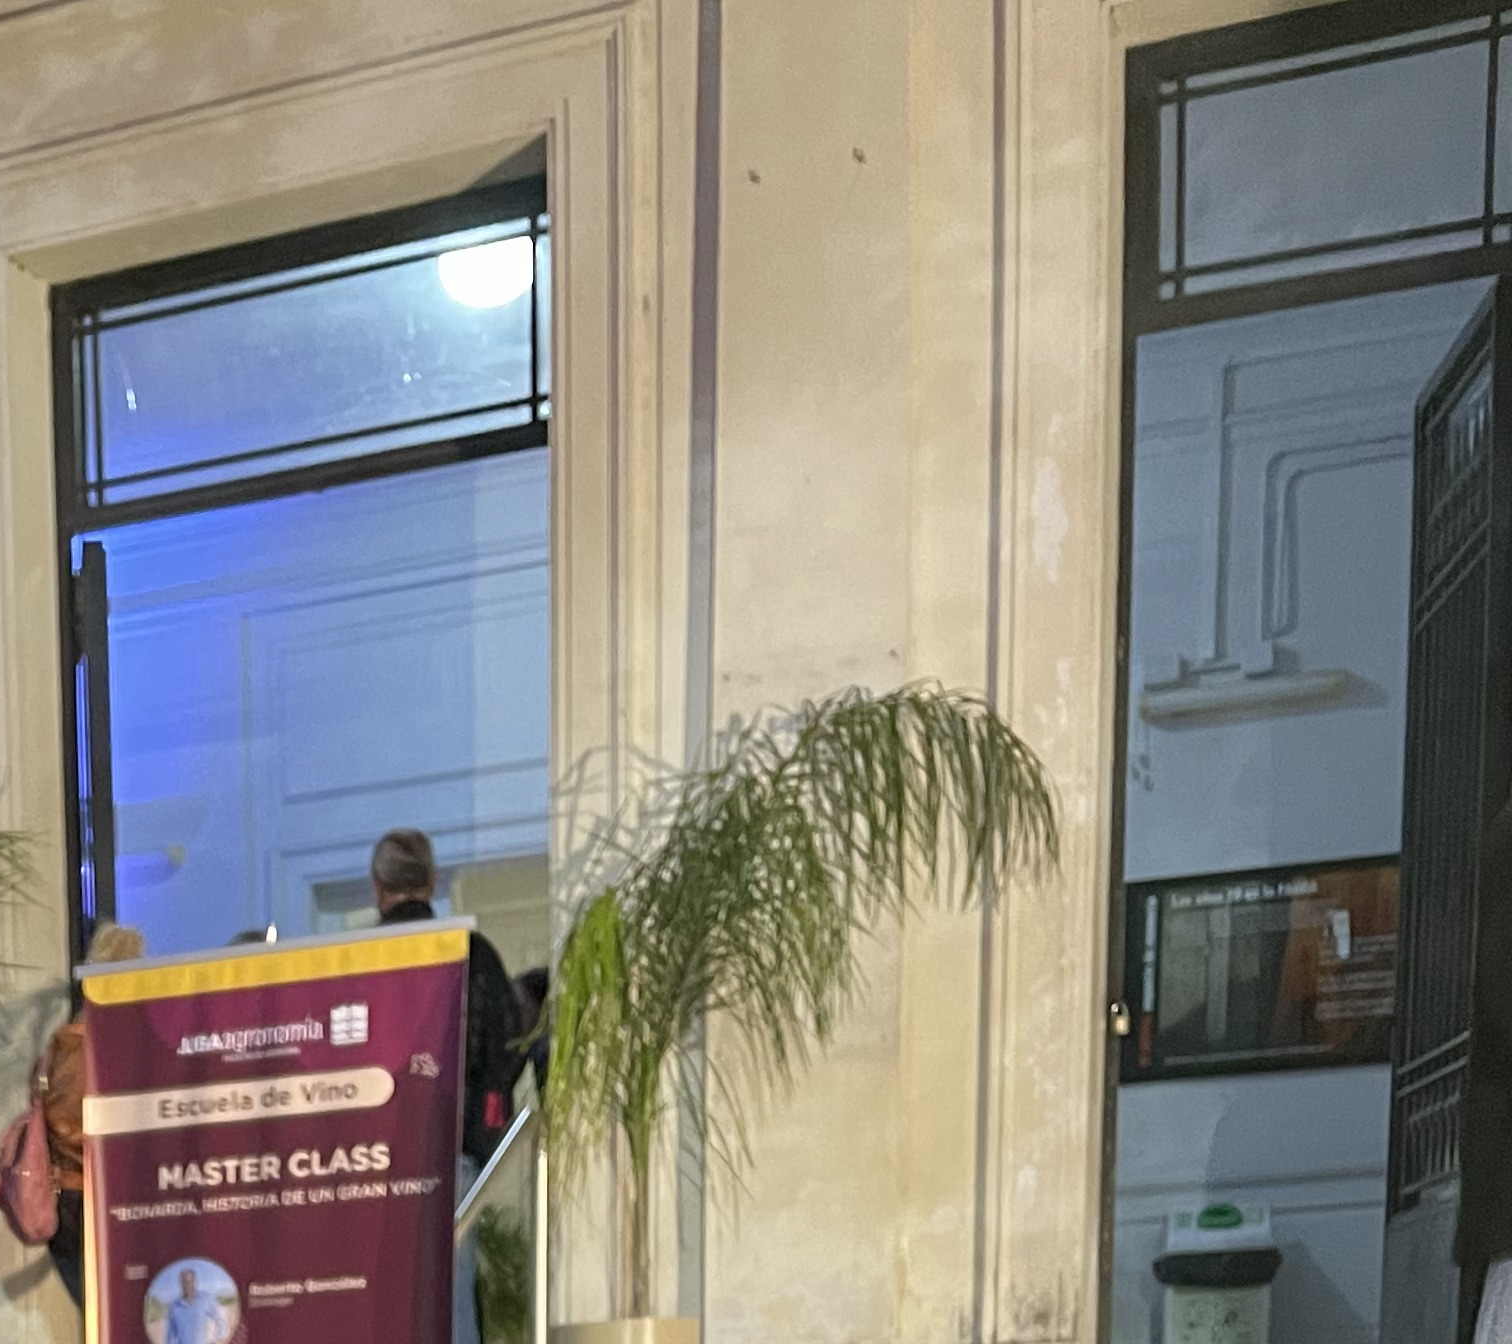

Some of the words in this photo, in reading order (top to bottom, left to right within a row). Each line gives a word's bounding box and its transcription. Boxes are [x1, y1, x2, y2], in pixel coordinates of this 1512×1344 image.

[158, 1091, 254, 1119] Escuela
[261, 1086, 291, 1108] de
[301, 1080, 358, 1104] Vino
[158, 1154, 280, 1190] MASTER
[288, 1143, 390, 1177] CLASS
